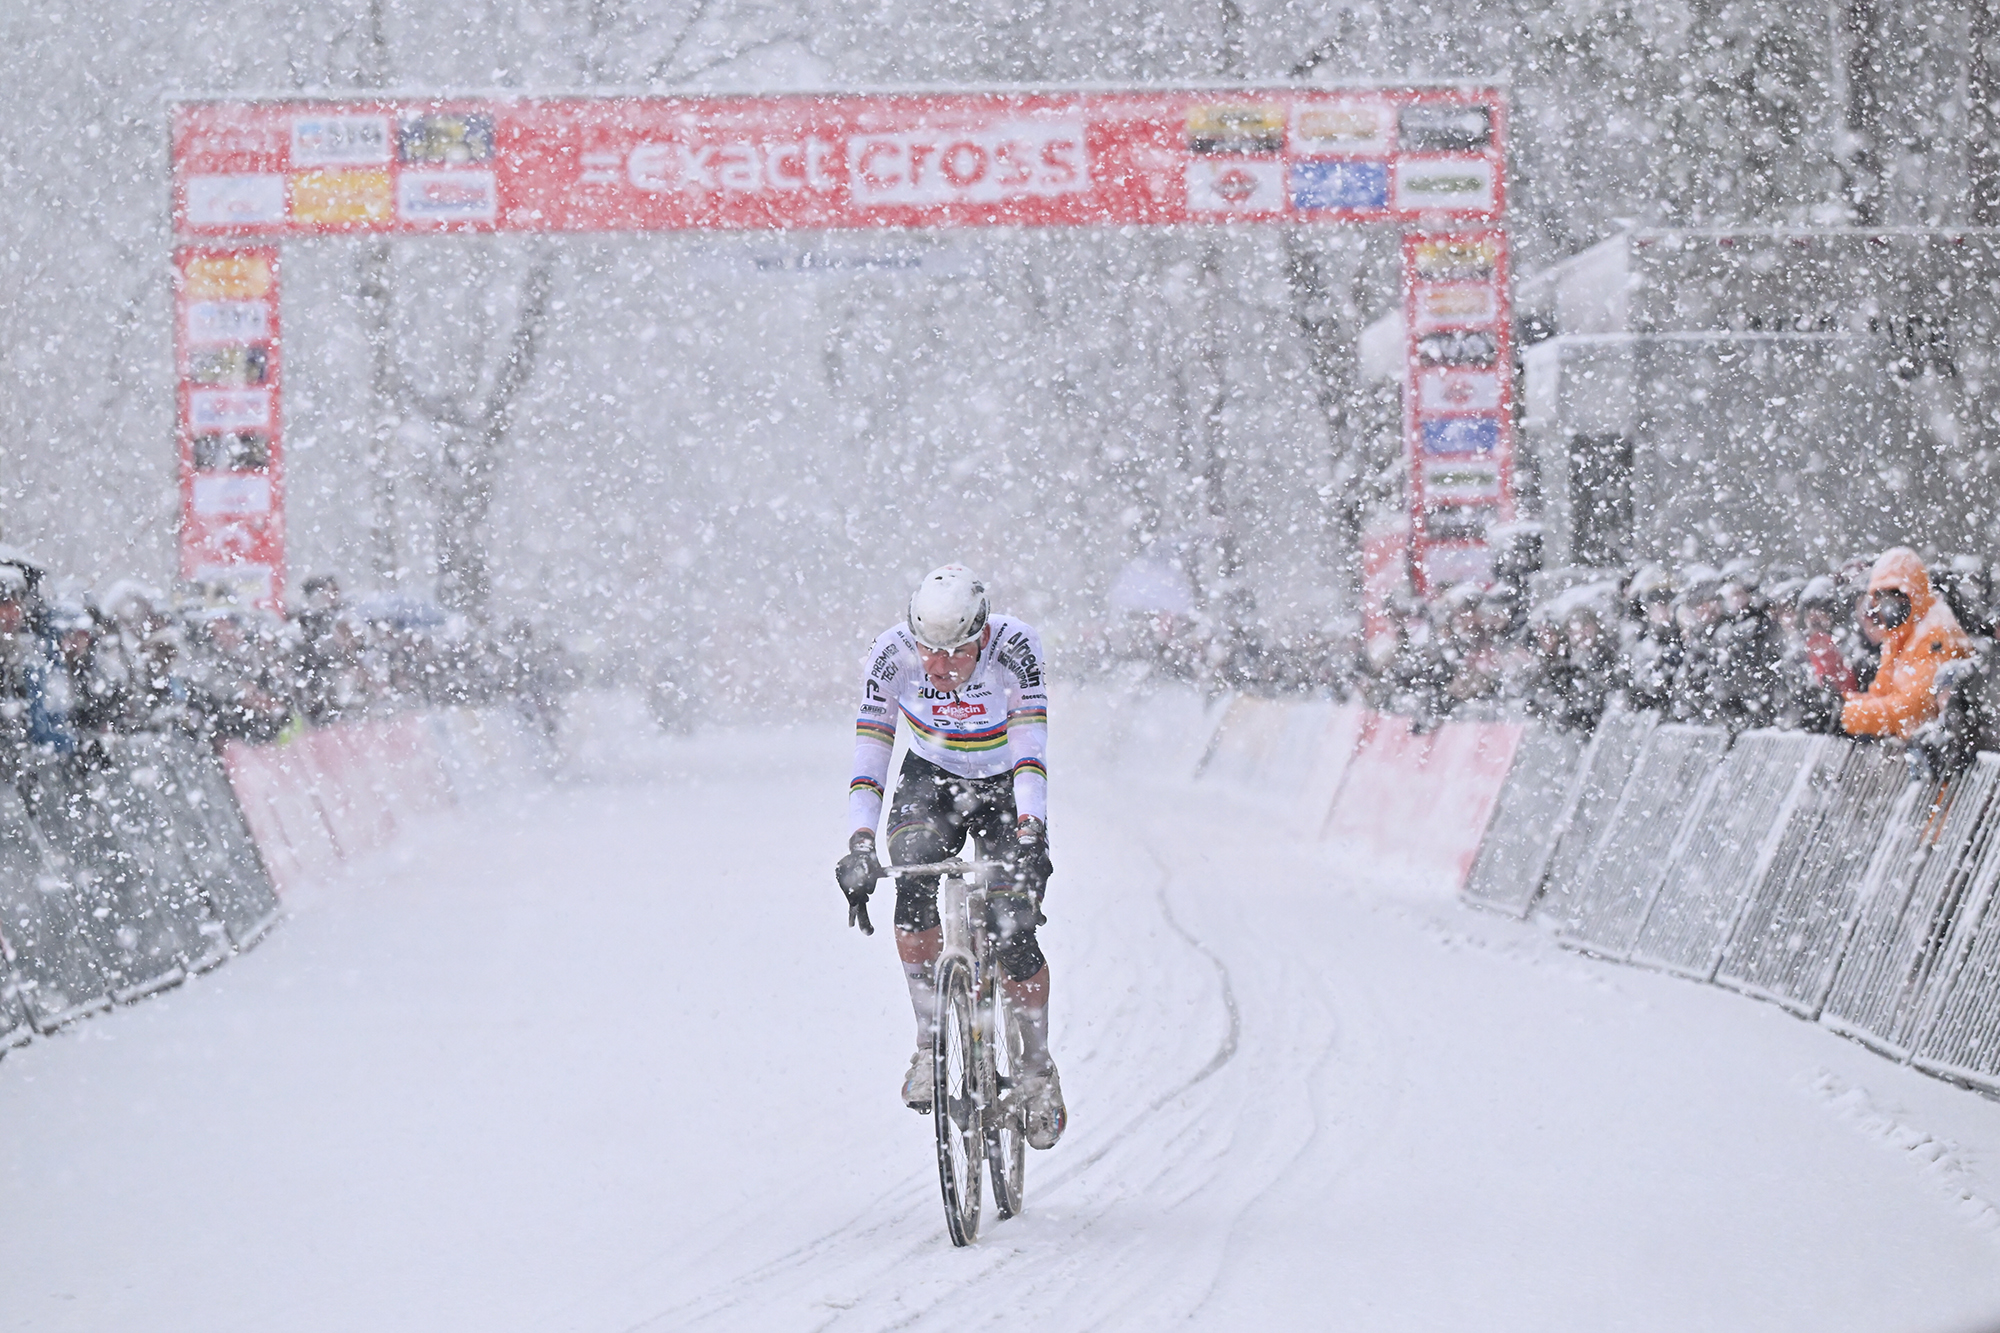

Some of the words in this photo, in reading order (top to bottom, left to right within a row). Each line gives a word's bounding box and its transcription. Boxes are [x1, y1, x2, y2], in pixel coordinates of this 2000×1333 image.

[628, 135, 834, 192] exact
[858, 140, 1078, 189] cross
[871, 643, 899, 678] PREMIER
[880, 661, 899, 683] TECH
[1007, 631, 1041, 688] Alpecin
[1008, 660, 1029, 689] SHAMPOO
[924, 687, 951, 700] UCI
[936, 704, 981, 716] Alpecin
